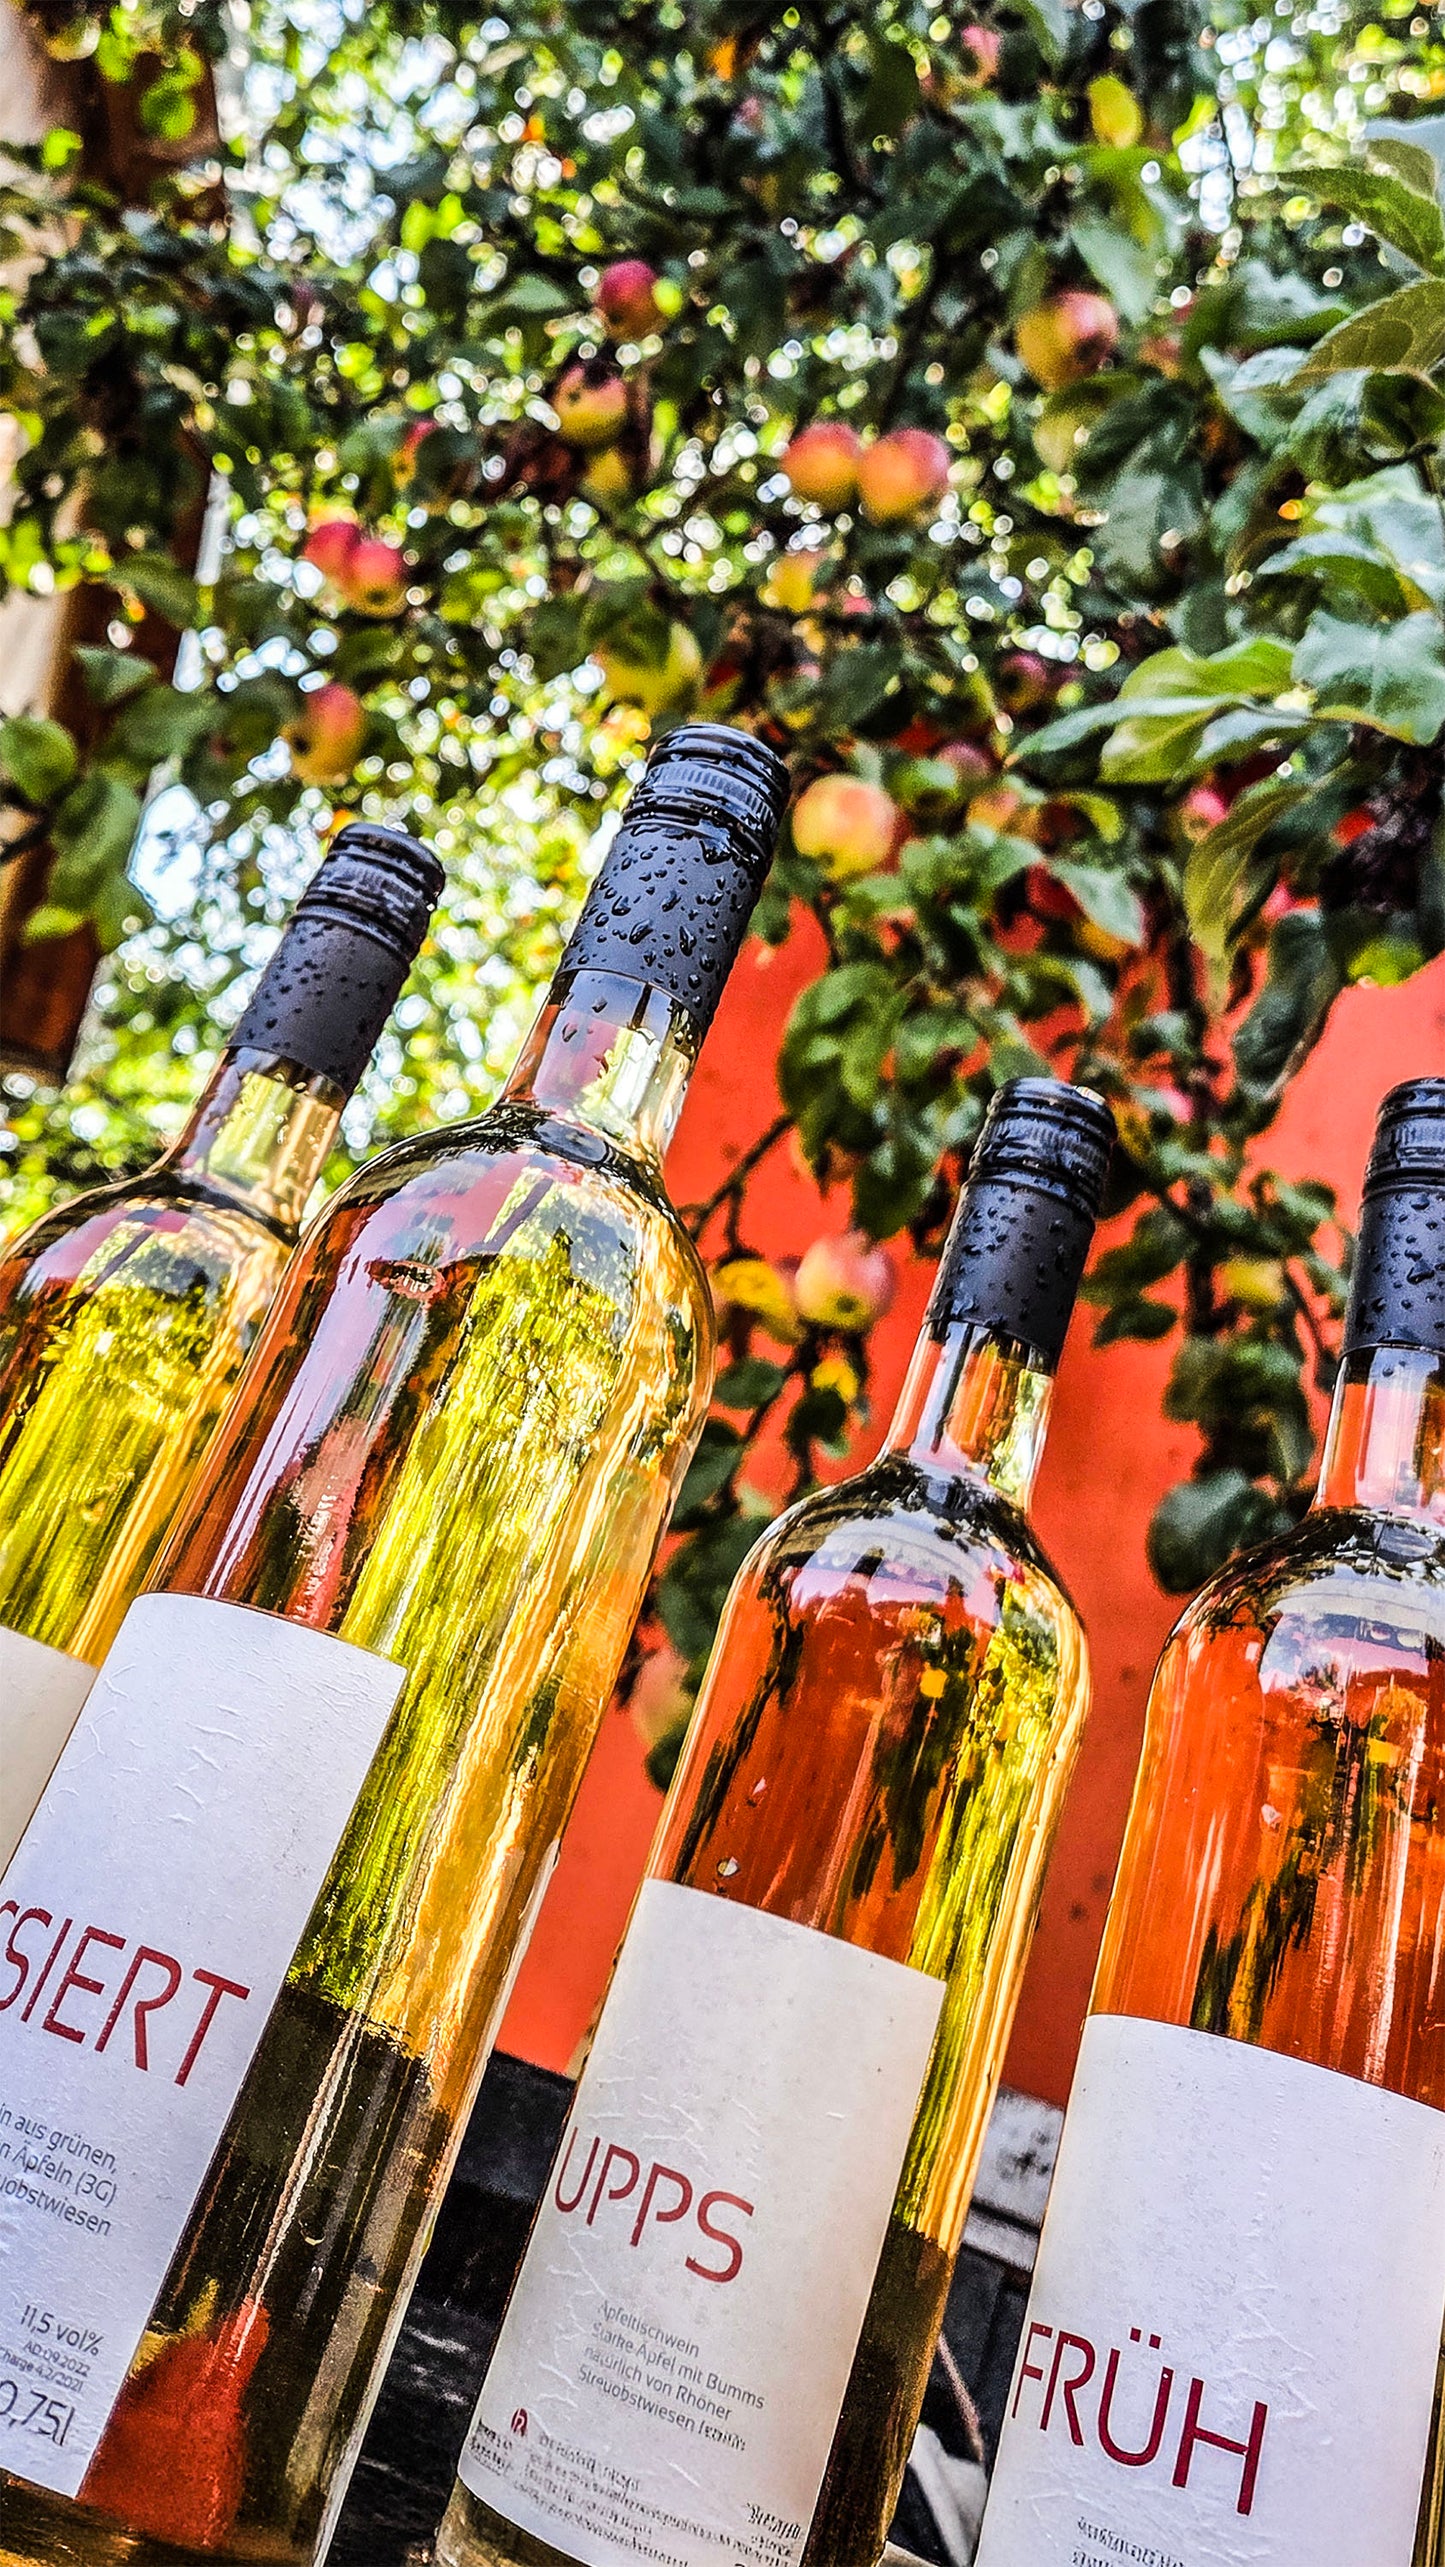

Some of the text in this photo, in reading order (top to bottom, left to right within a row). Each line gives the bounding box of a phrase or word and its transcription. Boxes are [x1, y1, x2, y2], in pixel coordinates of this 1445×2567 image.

[12, 2139, 73, 2185] Äpfeln
[75, 2170, 117, 2208] (3G)
[14, 2115, 47, 2140] aus
[47, 2131, 117, 2174] grünen,
[555, 2126, 754, 2283] UPPS
[56, 2323, 104, 2356] vol%
[578, 2363, 695, 2433] Streuobstwiesen
[646, 2373, 672, 2396] von
[675, 2384, 732, 2421] Rhöner
[678, 2364, 703, 2385] mit
[706, 2372, 766, 2410] Bumms
[1012, 2321, 1268, 2516] FRÜH
